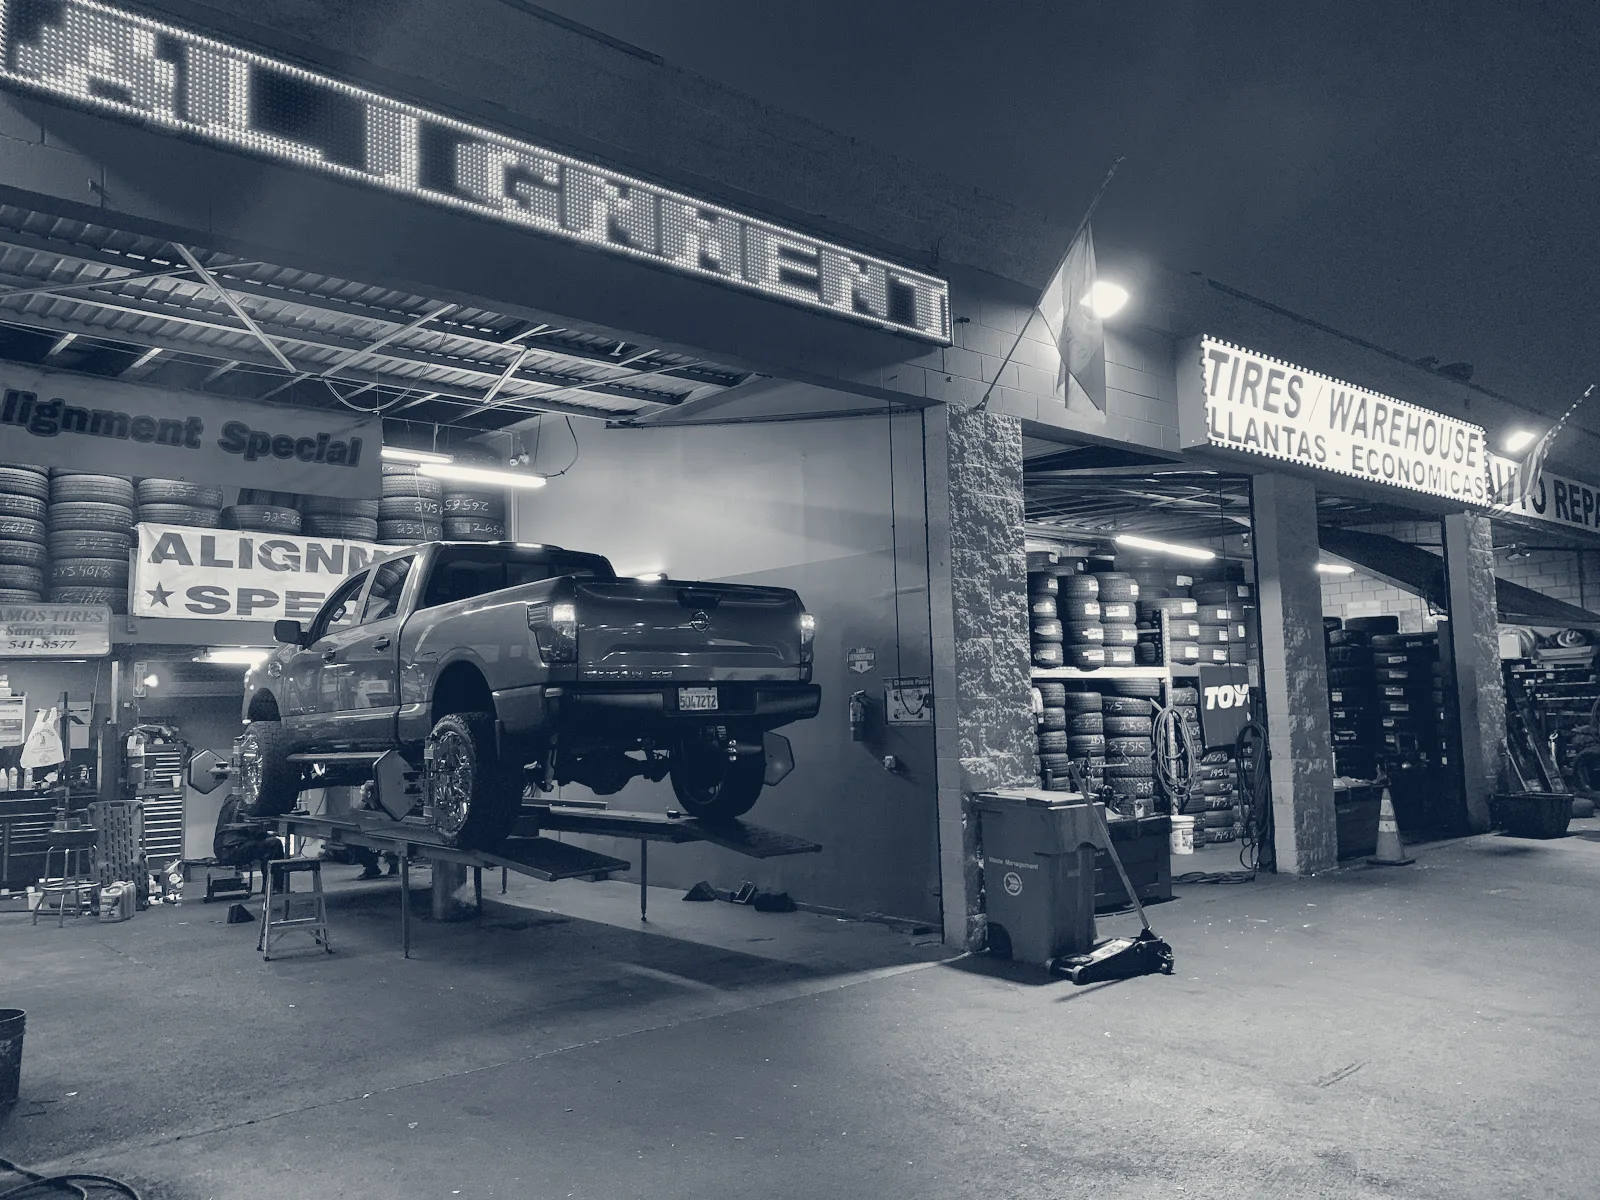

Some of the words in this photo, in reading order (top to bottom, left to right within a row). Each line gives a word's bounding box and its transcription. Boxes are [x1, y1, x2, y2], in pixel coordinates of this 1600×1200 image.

[14, 2, 948, 338] ALIGNMENT
[1209, 349, 1303, 418] TIRES
[1329, 388, 1479, 468] WAREHOUSE
[217, 420, 363, 467] Special
[1210, 406, 1327, 463] LLANTAS
[1352, 444, 1484, 500] ECONOMICAS
[5, 625, 45, 636] Santa
[50, 610, 104, 622] TIRES
[8, 640, 77, 649] 541-8577
[1204, 683, 1251, 711] TOY
